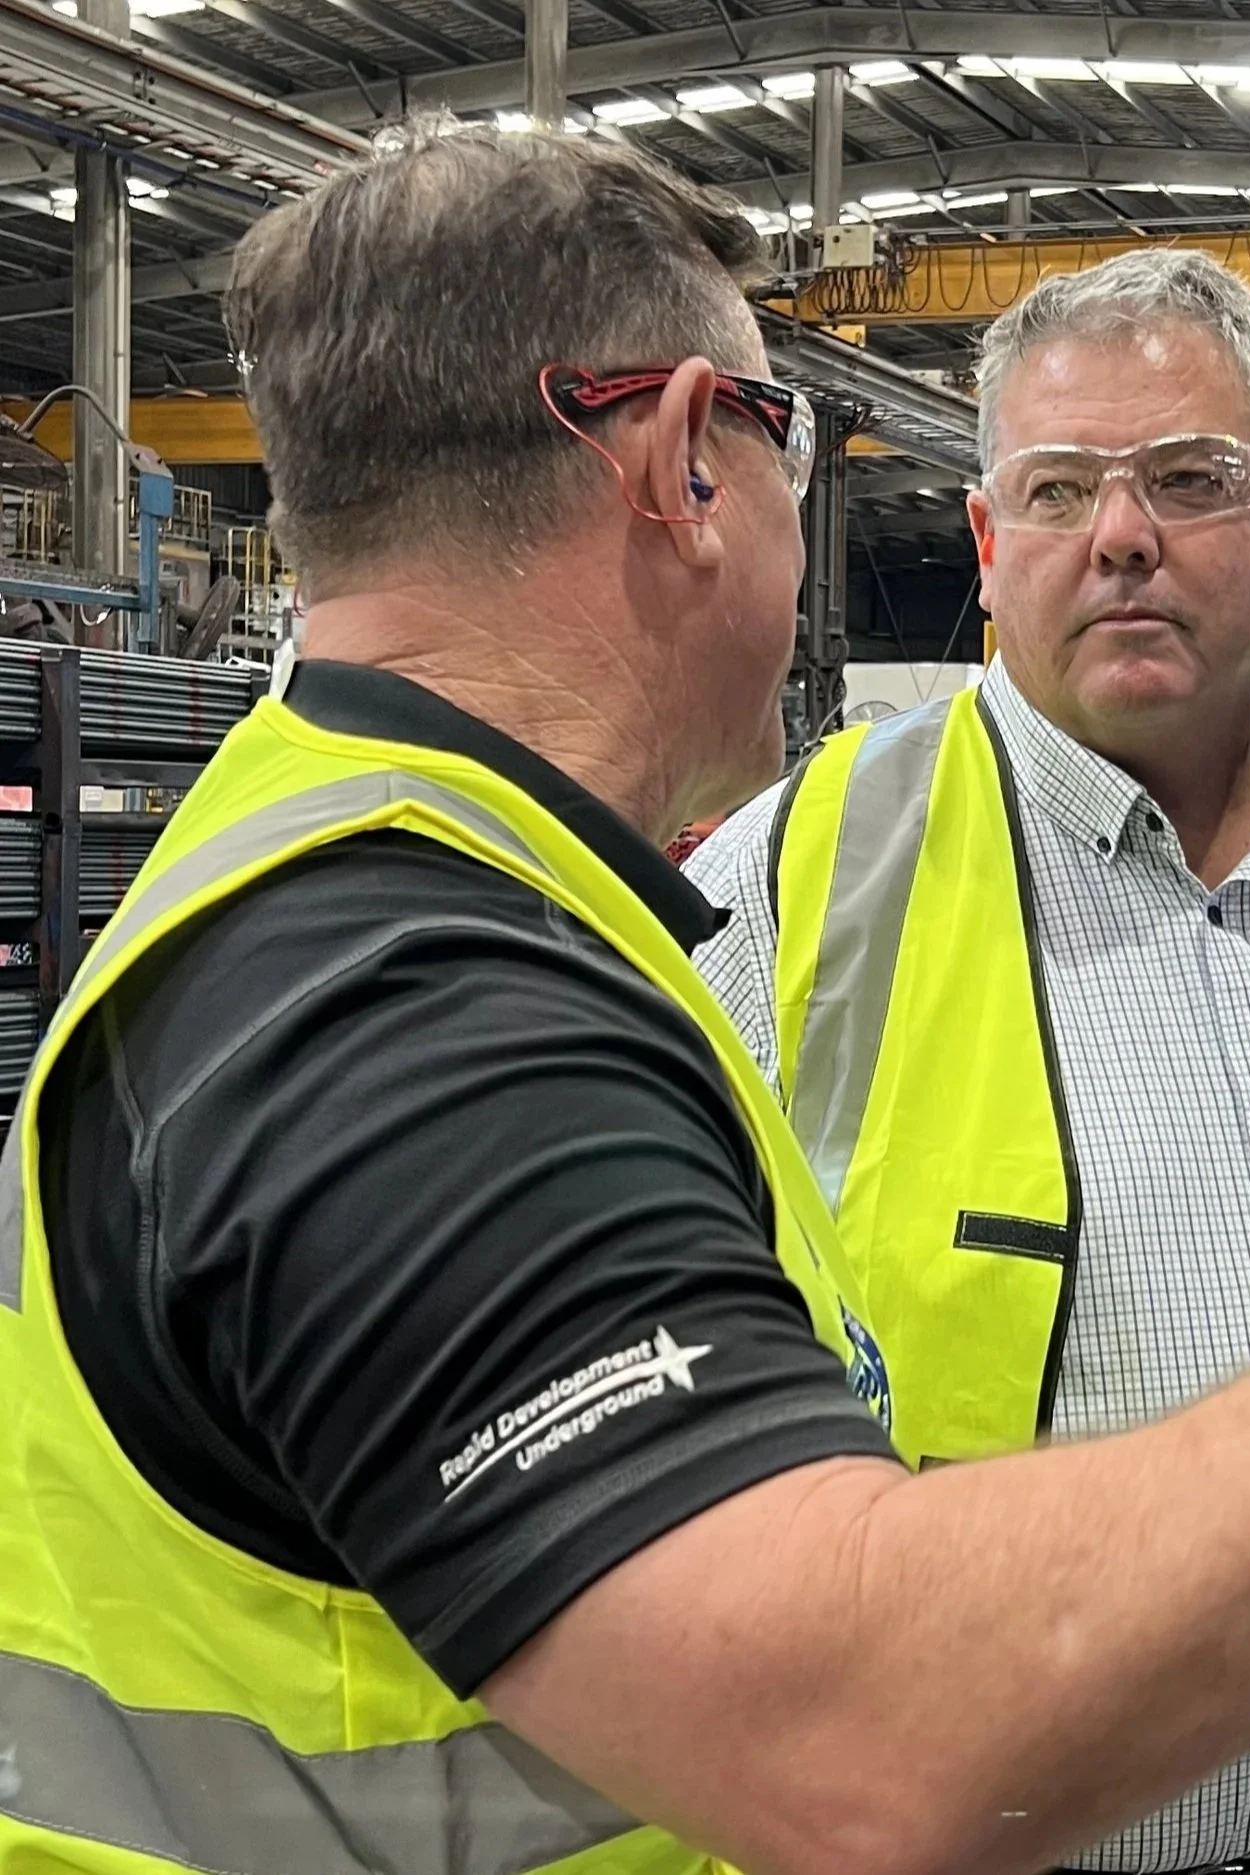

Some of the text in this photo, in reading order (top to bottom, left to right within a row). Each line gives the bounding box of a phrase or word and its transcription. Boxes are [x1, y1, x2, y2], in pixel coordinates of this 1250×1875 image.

[439, 1339, 652, 1487] Rapid Development
[515, 1373, 666, 1472] Underground
